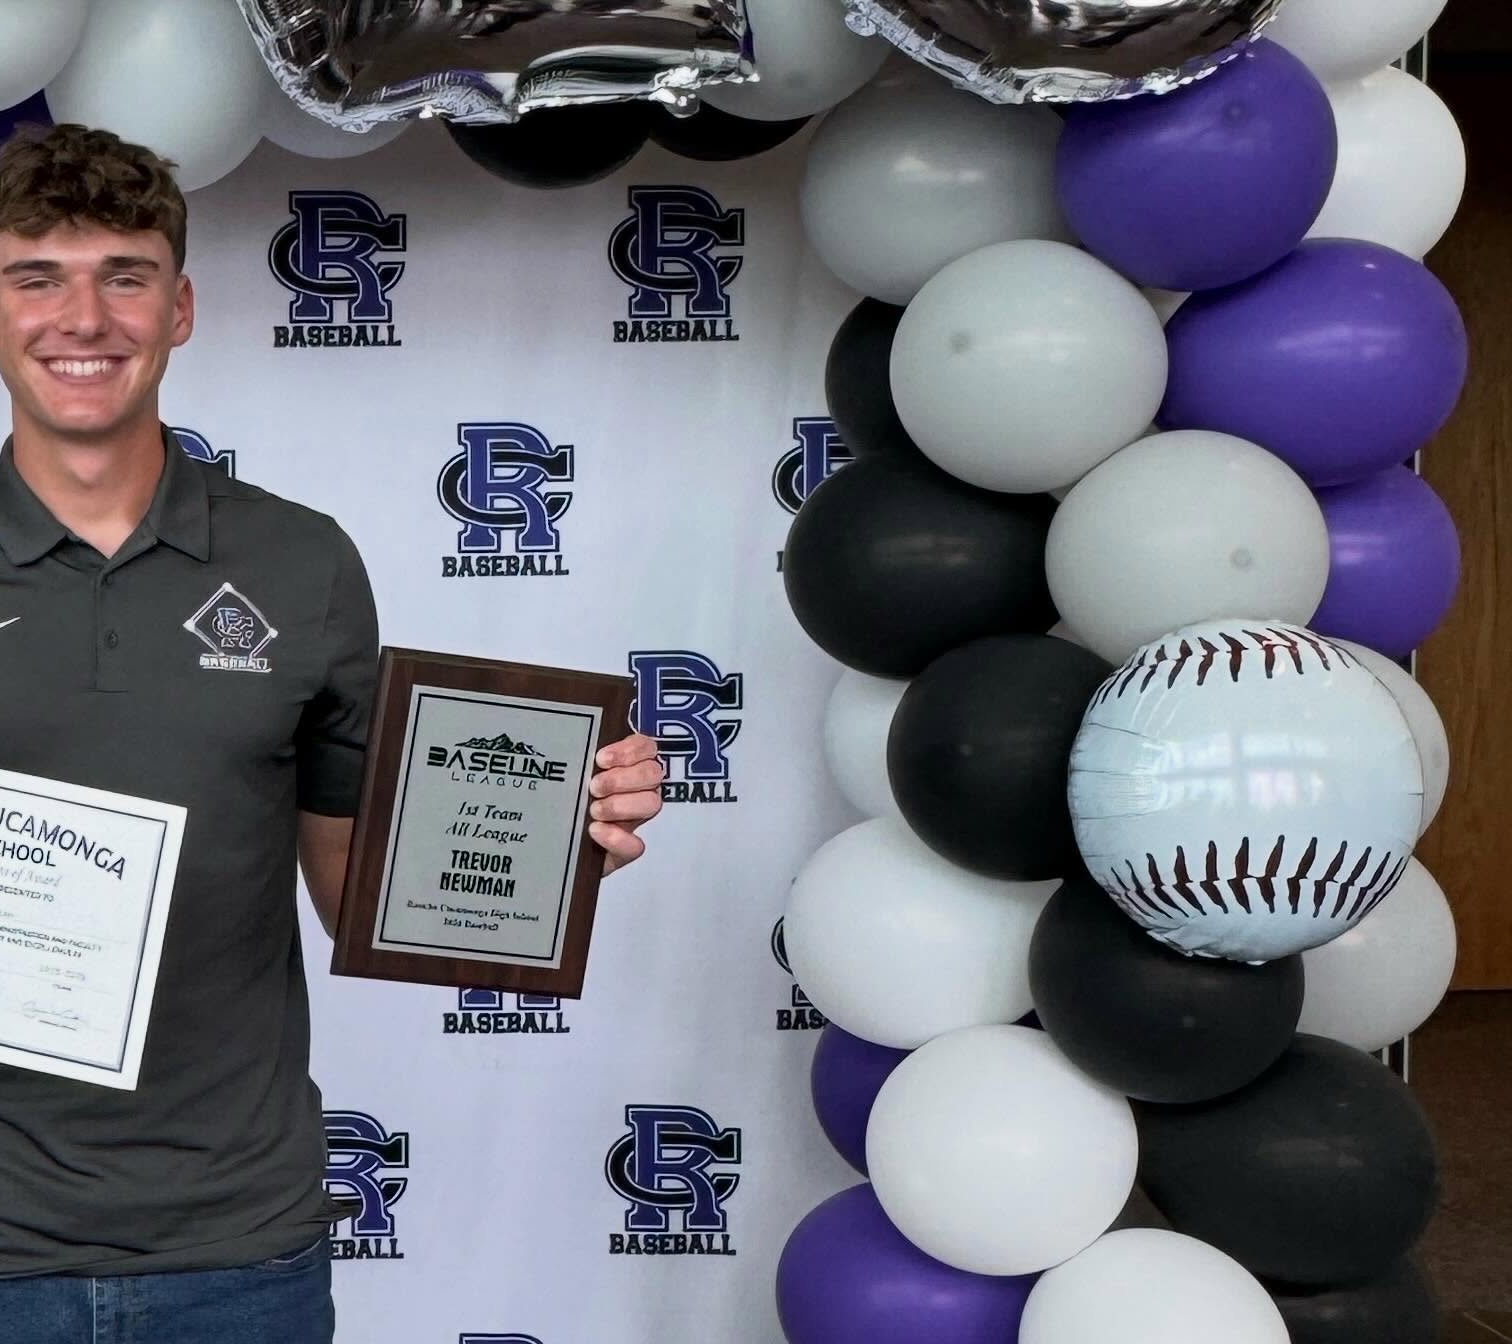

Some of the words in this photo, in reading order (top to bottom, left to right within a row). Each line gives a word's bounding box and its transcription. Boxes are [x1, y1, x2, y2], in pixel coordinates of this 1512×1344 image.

[274, 324, 402, 347] BASEBALL
[613, 319, 739, 342] BASEBALL
[442, 555, 569, 577] BASEBALL
[427, 746, 568, 782] BASELINE
[451, 772, 538, 791] LEAGUE
[661, 781, 738, 804] EBALL
[484, 805, 523, 821] Team
[472, 823, 528, 844] League
[451, 849, 513, 874] TREVOR
[439, 871, 516, 898] NEWMAN
[443, 1012, 570, 1035] BASEBALL
[329, 1238, 404, 1260] EBALL
[609, 1234, 736, 1256] BASEBALL
